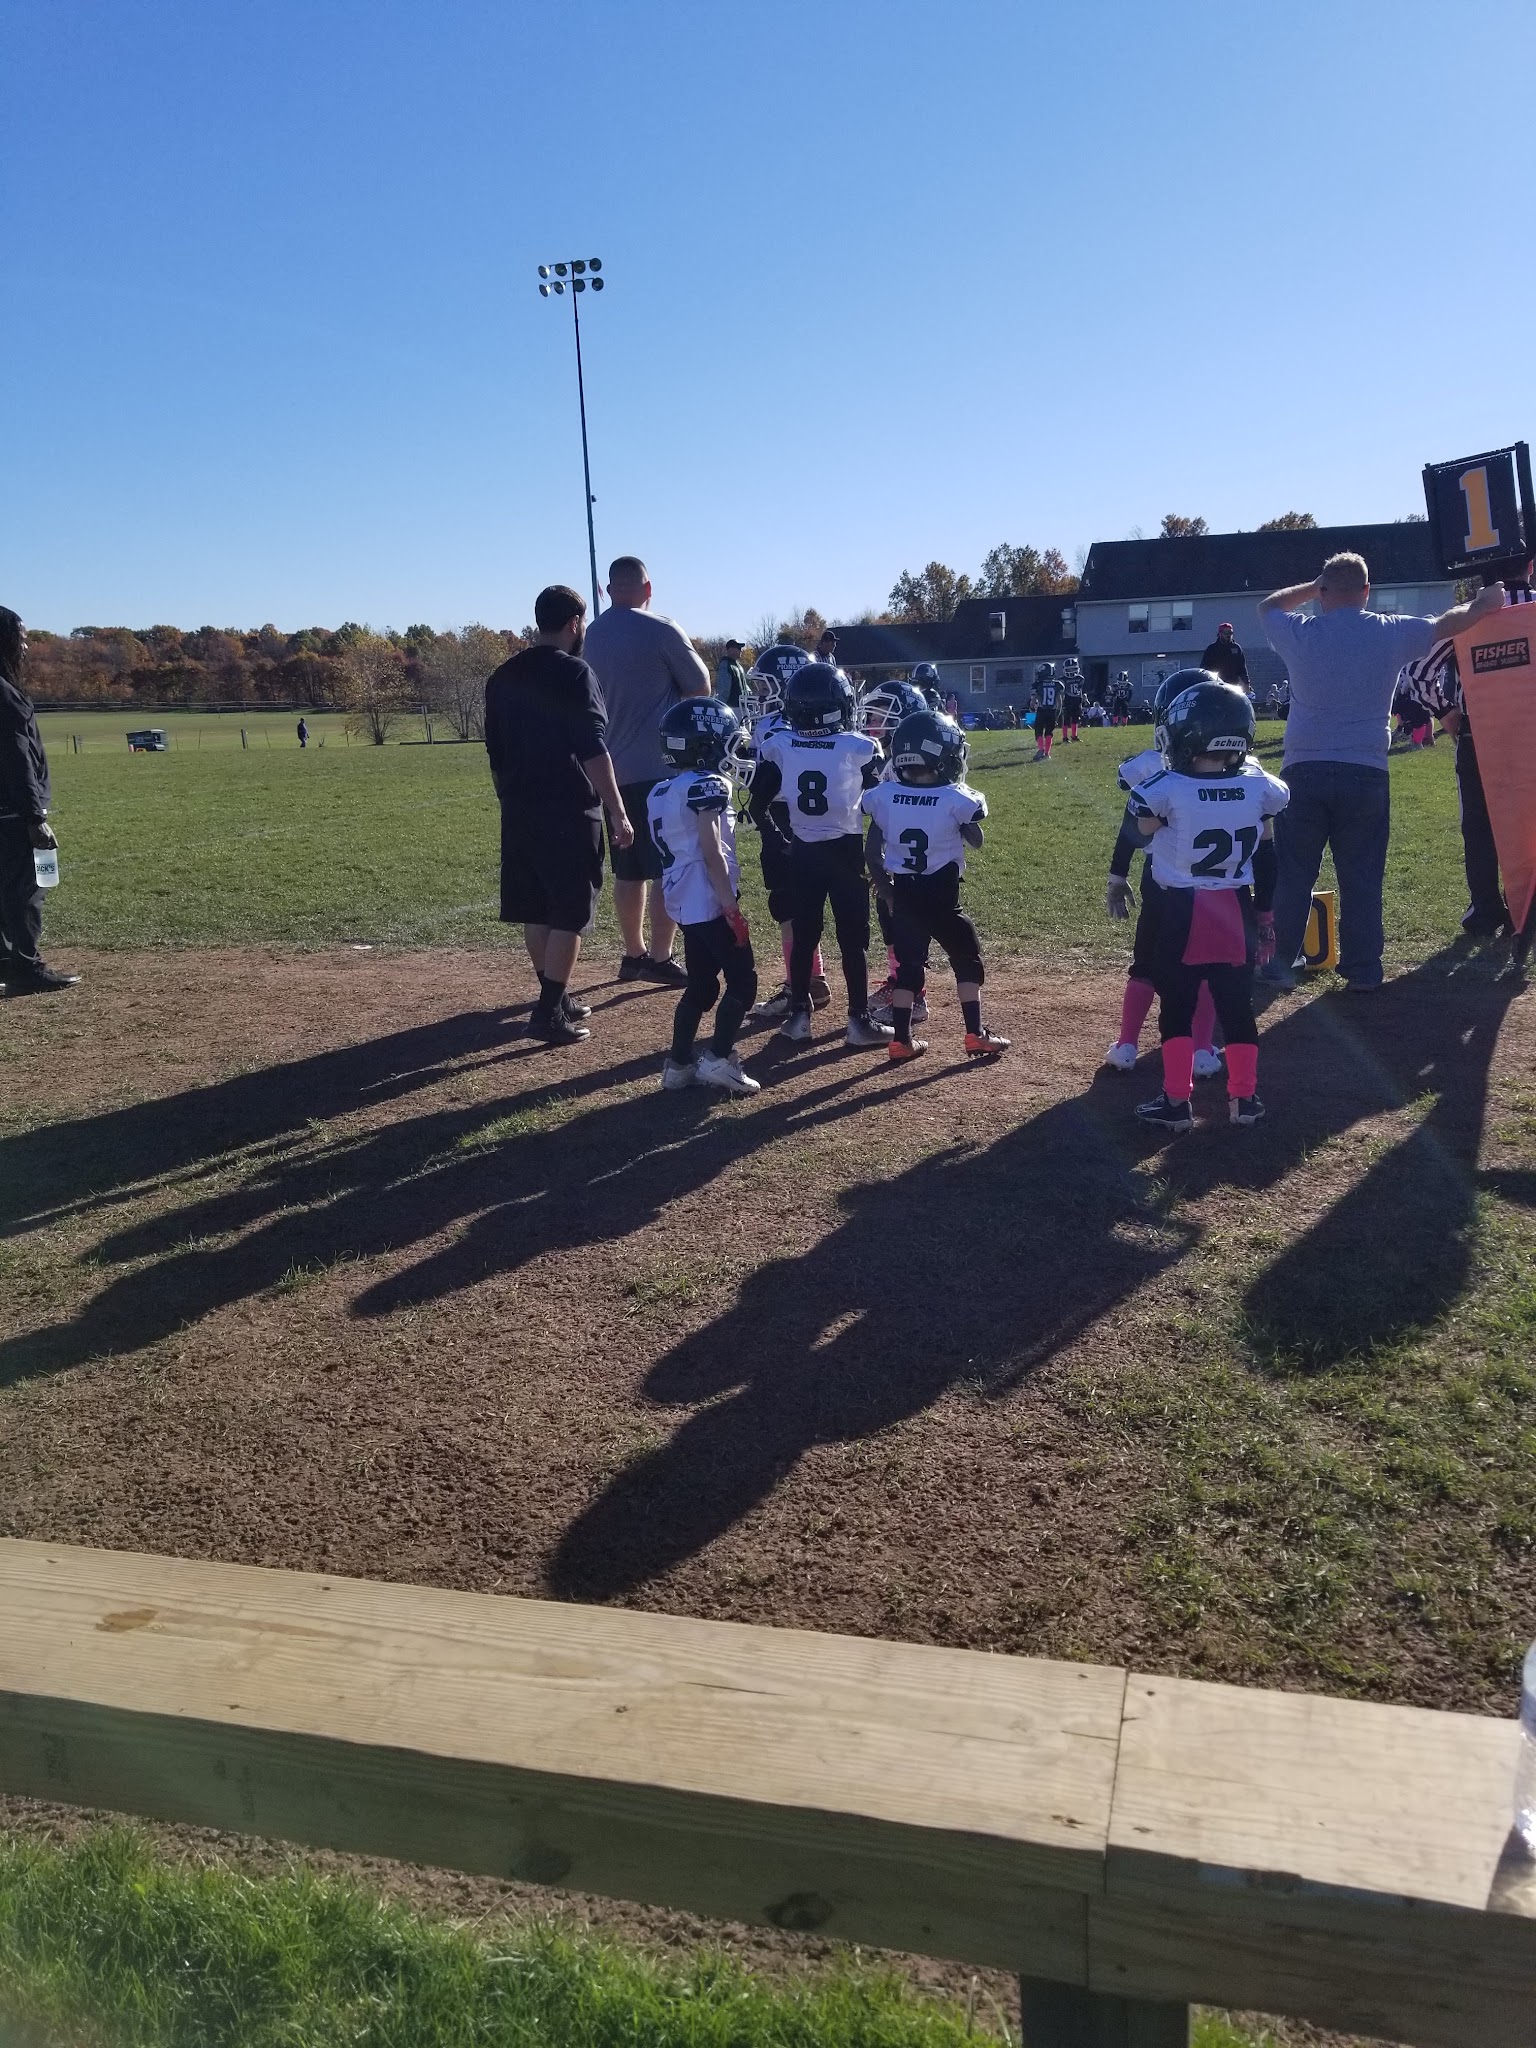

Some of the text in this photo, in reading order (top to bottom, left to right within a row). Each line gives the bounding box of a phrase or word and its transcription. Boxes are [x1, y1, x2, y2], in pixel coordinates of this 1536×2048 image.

[1459, 466, 1500, 552] 1
[1475, 642, 1527, 663] FISHER
[1042, 687, 1055, 705] 19
[904, 742, 911, 751] 18
[797, 770, 829, 816] 8
[892, 794, 940, 806] STEWART
[1198, 787, 1245, 801] OWENS
[899, 828, 929, 874] 3
